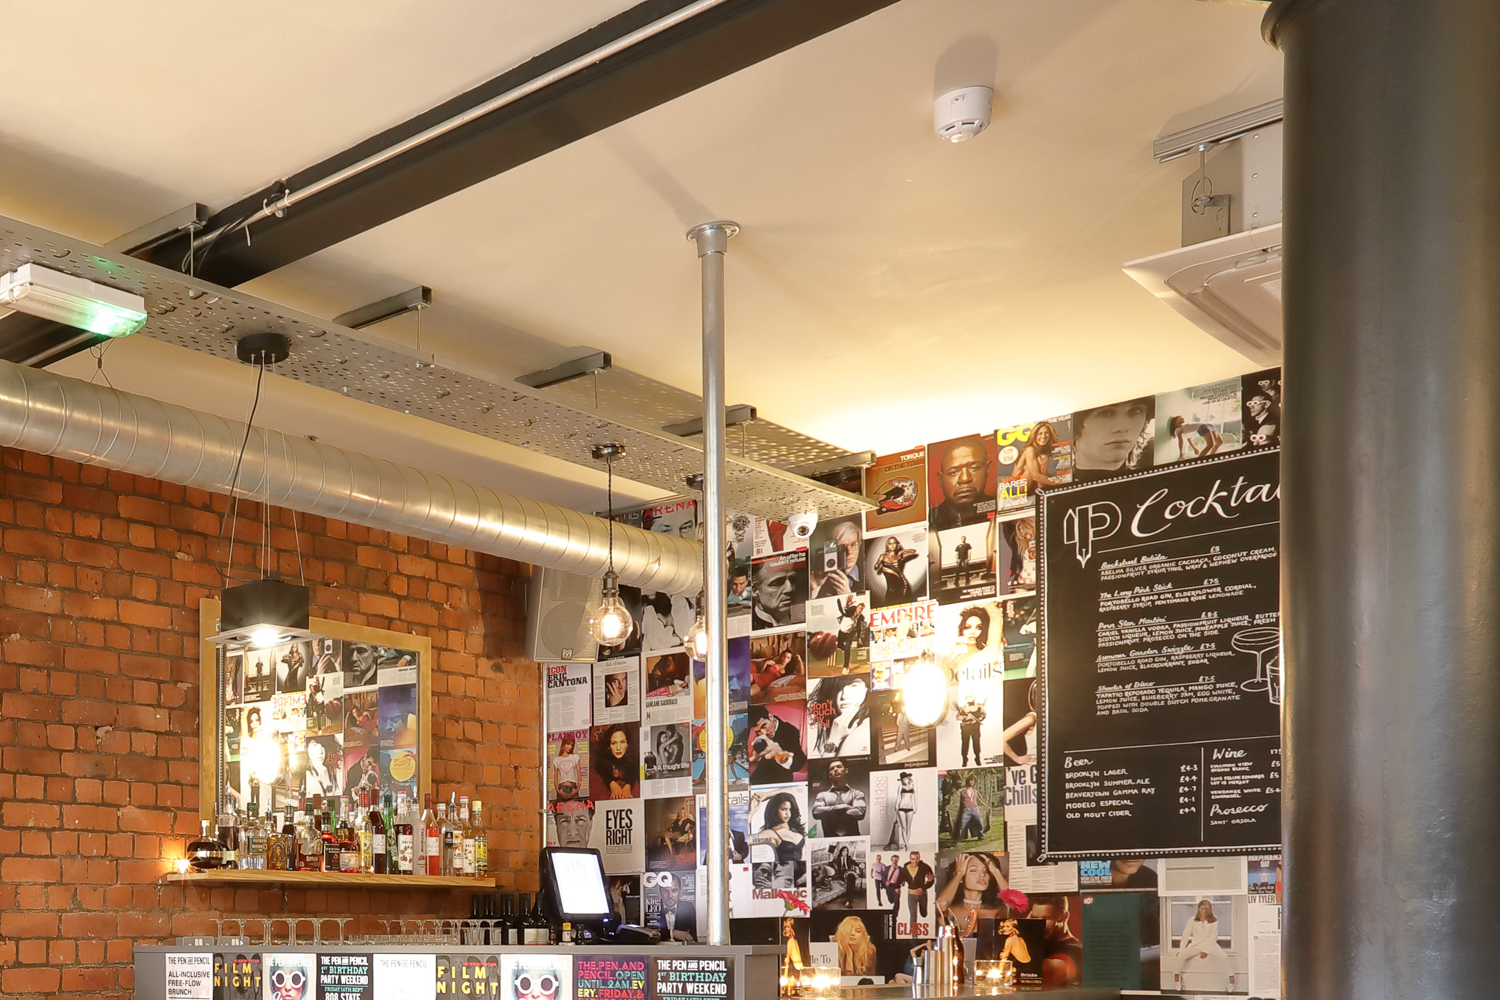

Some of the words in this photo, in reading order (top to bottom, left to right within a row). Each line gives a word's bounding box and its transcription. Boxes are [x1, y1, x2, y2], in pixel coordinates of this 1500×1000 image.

[900, 451, 925, 462] TORQUE
[999, 479, 1028, 491] BARES
[999, 487, 1028, 500] ALL!
[643, 499, 697, 518] ARENA
[1141, 594, 1158, 603] ROAD
[870, 603, 936, 627] EMPIRE
[547, 665, 567, 675] ICON
[547, 672, 568, 682] ERIC
[547, 676, 588, 688] CANTONA
[1212, 747, 1248, 760] Wine
[662, 763, 680, 774] thug's
[1064, 756, 1094, 769] Beer
[1065, 771, 1100, 780] BROOKLYN
[1103, 768, 1129, 776] LAGER
[1065, 781, 1100, 790] BROOKLYN
[1103, 778, 1135, 787] SUMMER
[1136, 777, 1151, 785] ALE
[1004, 785, 1038, 806] Chills
[1065, 790, 1110, 800] BEAVERTOWN
[1112, 788, 1139, 796] GAMMA
[1141, 787, 1156, 795] RAY
[547, 800, 595, 813] ARENA
[1065, 801, 1096, 810] MODELO
[1100, 799, 1134, 807] ESPECIAL
[1209, 803, 1269, 817] Prosecco
[605, 809, 633, 829] EYES
[1108, 809, 1132, 817] CIDER
[605, 828, 633, 846] RIGHT
[1080, 860, 1111, 869] NEW
[1080, 868, 1112, 877] COOL
[643, 871, 673, 888] GQ
[1258, 895, 1276, 903] TYLER
[897, 922, 929, 936] CLASS
[168, 956, 176, 965] THE
[177, 957, 187, 965] PEN
[194, 957, 211, 965] PENCIL
[657, 960, 670, 971] THE
[672, 960, 687, 971] PEN
[687, 960, 699, 971] AND
[700, 960, 728, 972] PENCIL
[214, 963, 252, 974] FILM
[329, 966, 368, 975] BIRTHDAY
[437, 966, 487, 979] FILM
[214, 976, 261, 988] NIGHT
[320, 975, 339, 985] PARTY
[340, 975, 369, 985] WEEKEND
[669, 972, 727, 983] BIRTHDAY
[436, 981, 499, 995] NIGHT
[657, 982, 683, 994] PARTY
[686, 983, 727, 995] WEEKEND
